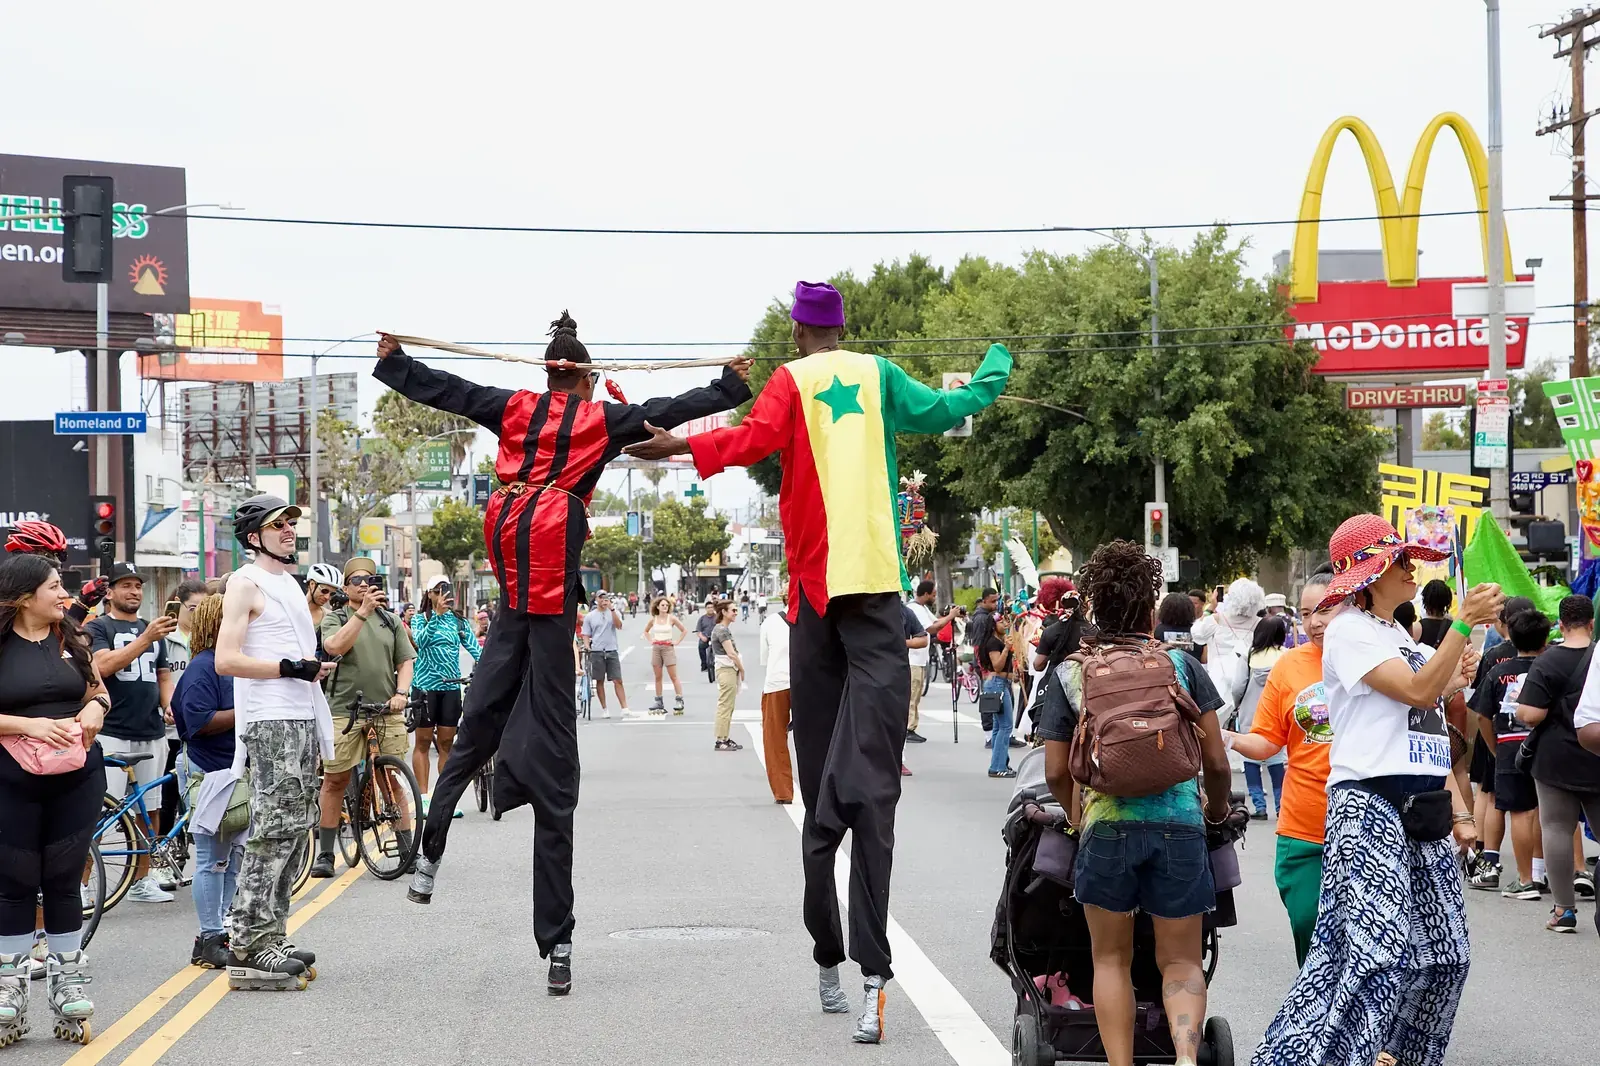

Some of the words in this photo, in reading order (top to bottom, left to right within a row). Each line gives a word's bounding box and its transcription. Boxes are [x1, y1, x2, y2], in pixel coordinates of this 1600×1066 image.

[0, 194, 149, 239] ELLSS
[0, 243, 64, 263] en.or
[1293, 318, 1521, 350] McDonalds
[1351, 387, 1462, 406] DRIVE-THRU
[59, 417, 122, 430] Homeland
[127, 417, 142, 430] Dr
[1550, 473, 1568, 483] ST.
[1298, 689, 1318, 704] OAK
[1409, 751, 1426, 764] OF
